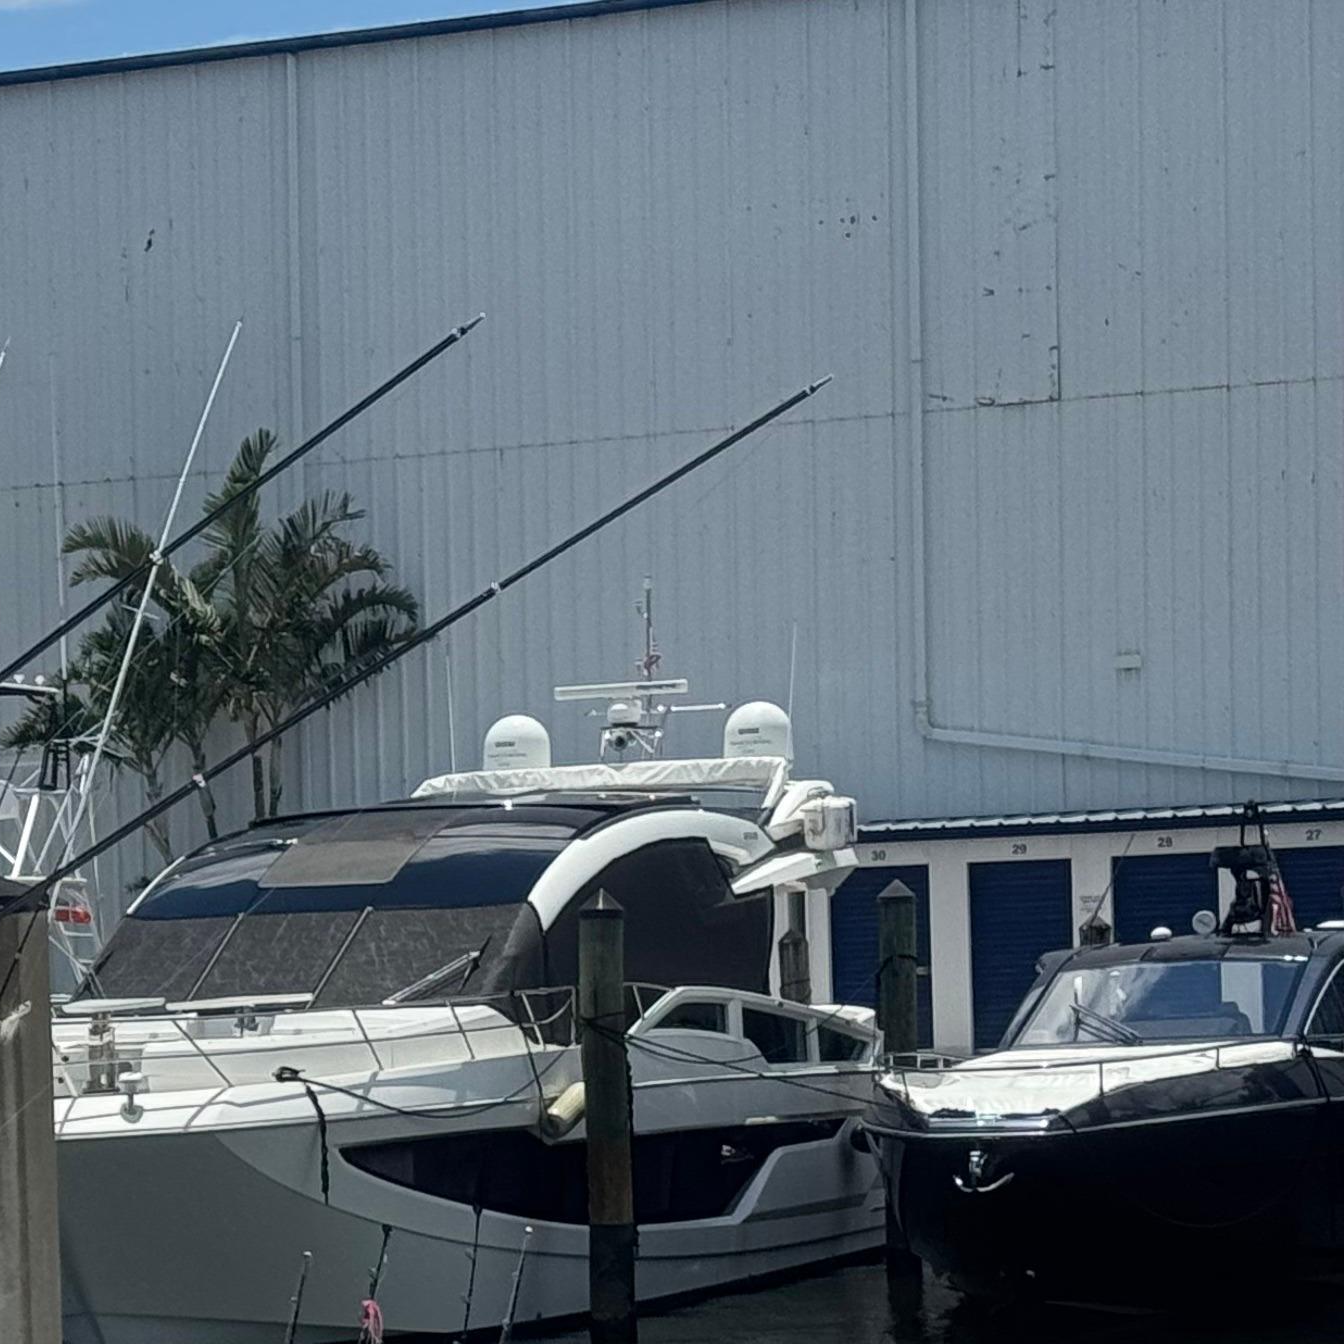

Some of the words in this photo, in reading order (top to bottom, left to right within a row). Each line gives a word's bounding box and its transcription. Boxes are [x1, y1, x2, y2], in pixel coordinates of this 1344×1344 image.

[1305, 829, 1322, 841] 27
[1012, 844, 1028, 855] 29
[871, 850, 887, 862] 30
